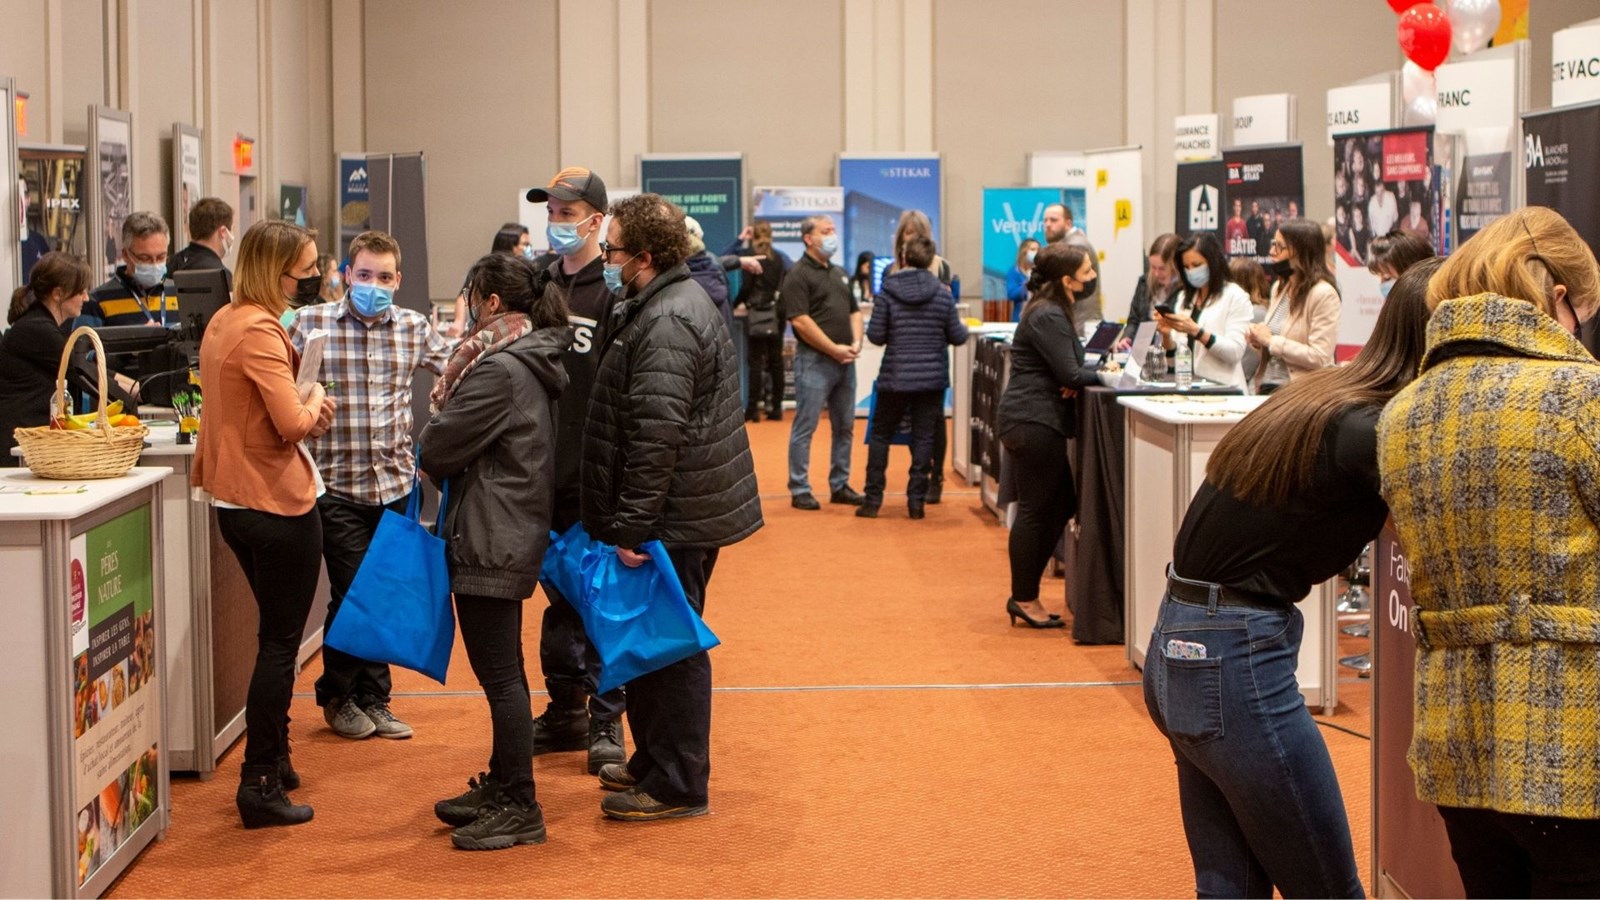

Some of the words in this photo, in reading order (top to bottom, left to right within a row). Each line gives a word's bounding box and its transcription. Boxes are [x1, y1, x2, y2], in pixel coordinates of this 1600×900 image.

[1334, 109, 1359, 125] ATLAS
[889, 167, 931, 178] STEKAR
[46, 198, 80, 209] IPEX
[794, 197, 839, 207] STEKAR
[1230, 235, 1257, 255] BÂTIR
[100, 550, 119, 577] PÈRES
[98, 574, 122, 604] NATURE
[1389, 589, 1408, 632] On
